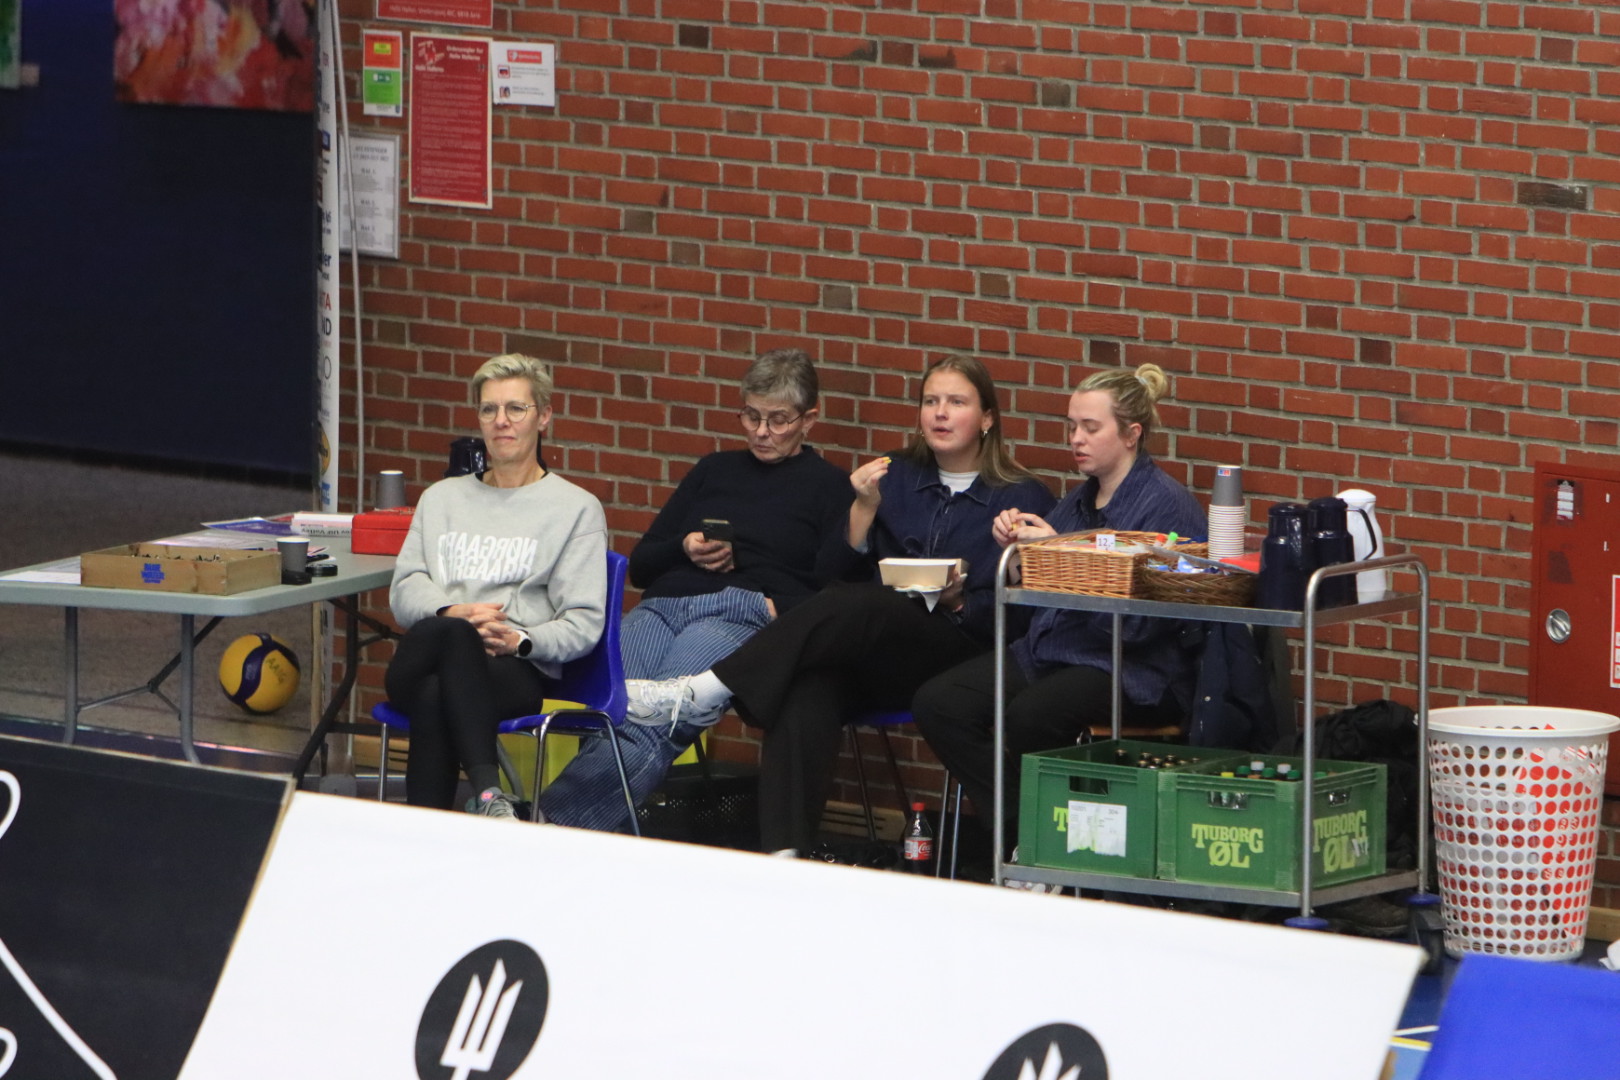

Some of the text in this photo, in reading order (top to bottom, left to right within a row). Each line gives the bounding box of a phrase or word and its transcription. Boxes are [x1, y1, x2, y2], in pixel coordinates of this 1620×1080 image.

[1191, 823, 1264, 853] TUBORG
[1312, 809, 1367, 853] TUBORG
[1208, 841, 1250, 868] ØL
[1323, 835, 1355, 874] ØL
